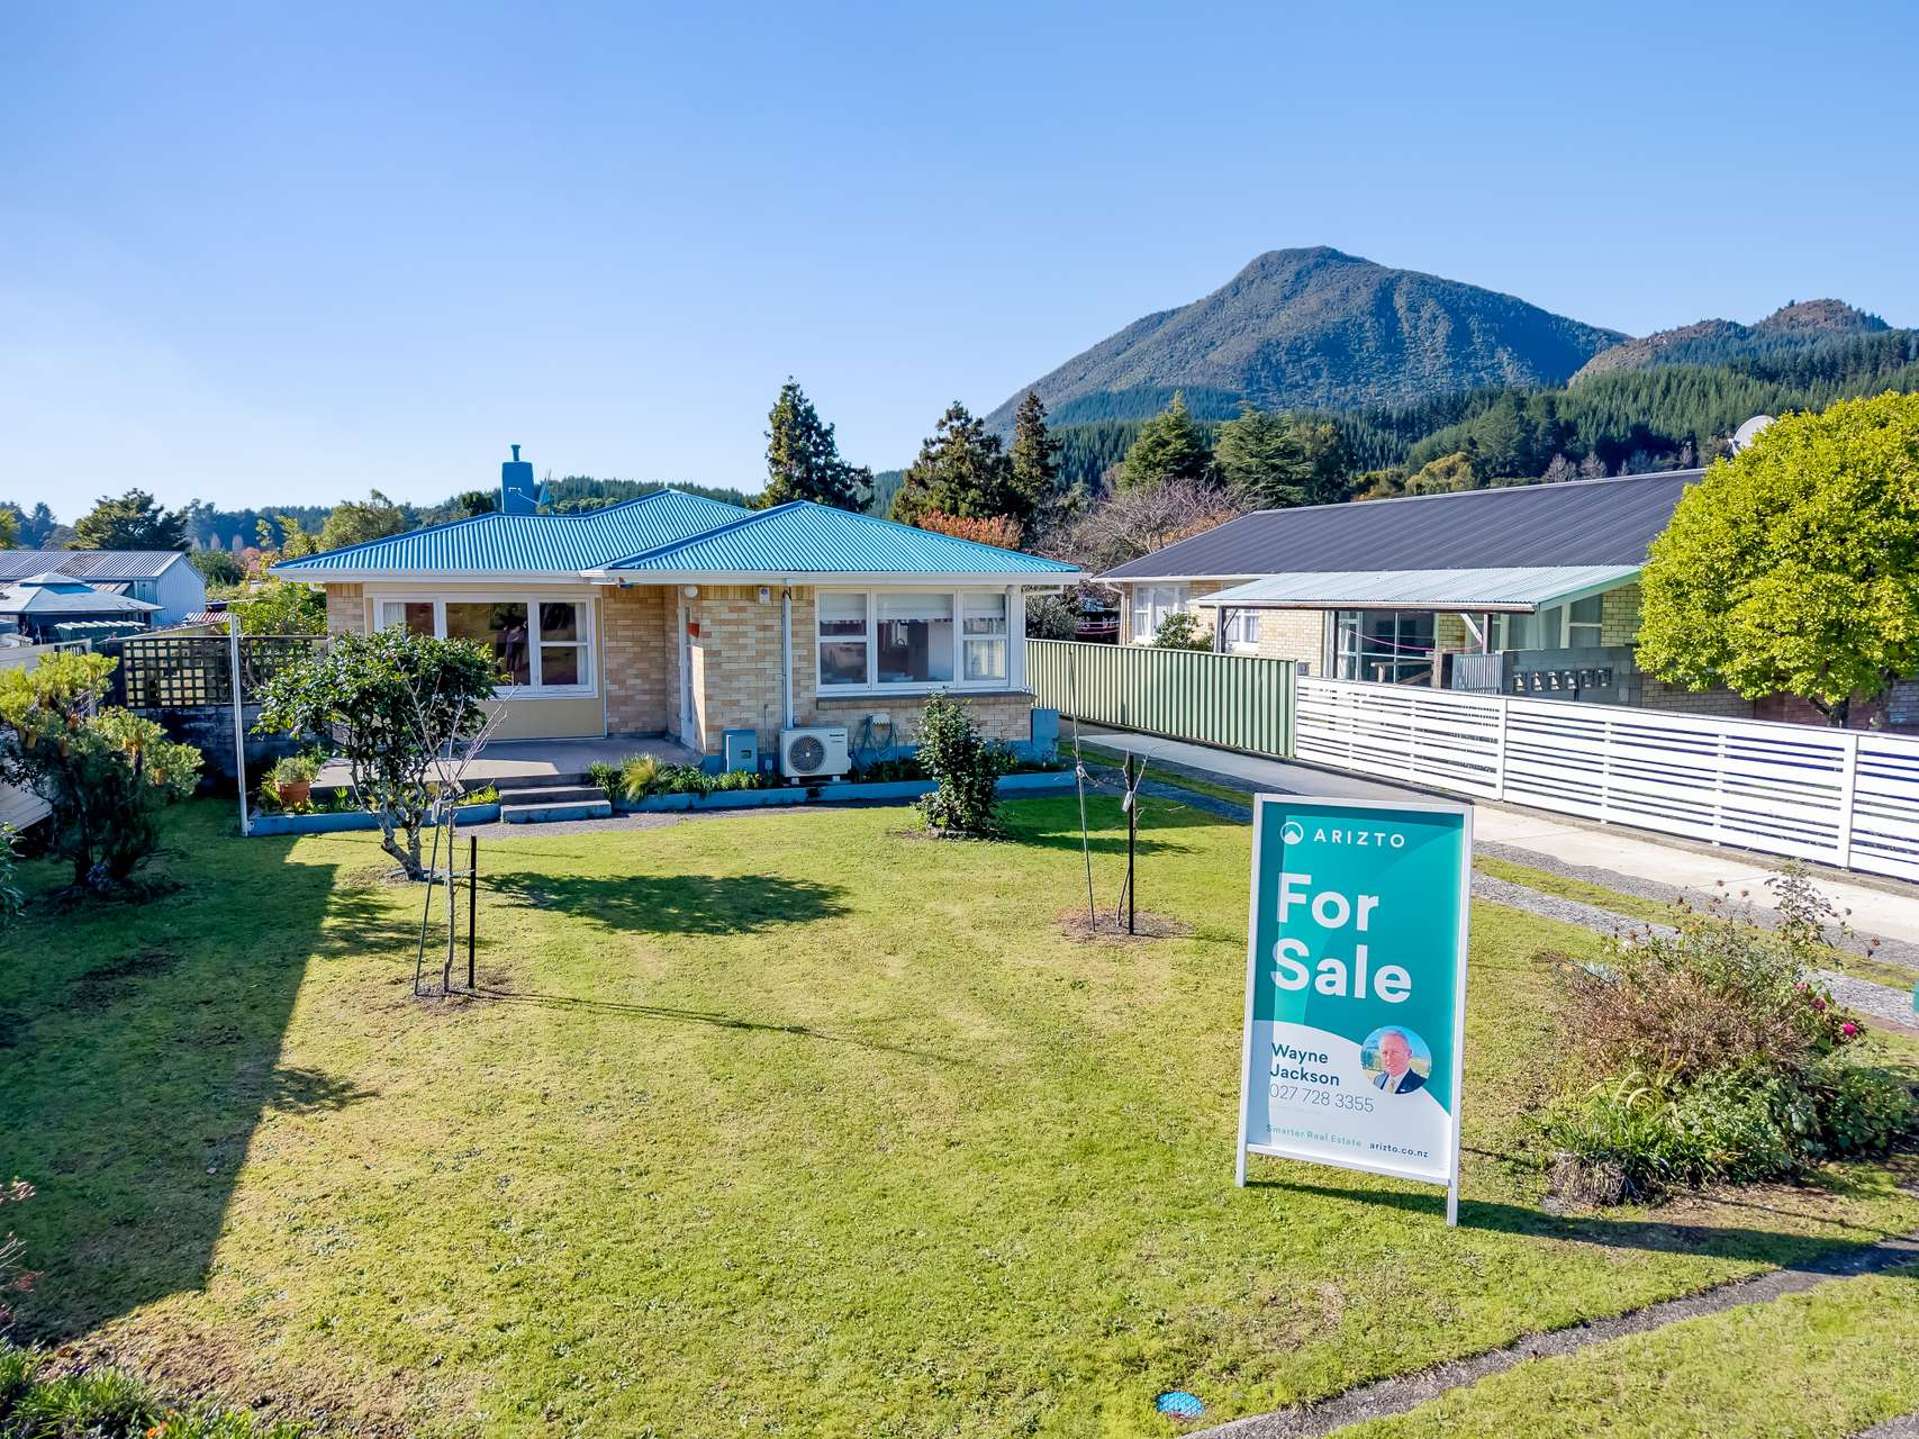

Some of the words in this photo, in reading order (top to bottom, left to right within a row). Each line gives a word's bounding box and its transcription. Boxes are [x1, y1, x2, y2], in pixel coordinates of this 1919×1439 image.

[1313, 828, 1405, 848] ARIZTO
[1276, 872, 1379, 931] For
[1270, 938, 1412, 1003] Sale
[1271, 1042, 1328, 1064] Wayne
[1270, 1064, 1340, 1086] Jackson
[1270, 1083, 1298, 1101] 027
[1302, 1088, 1331, 1106] 728
[1335, 1093, 1374, 1113] 3355
[1306, 1130, 1329, 1142] Real
[1331, 1134, 1362, 1147] Estate
[1369, 1142, 1429, 1158] arizto.co.nz
